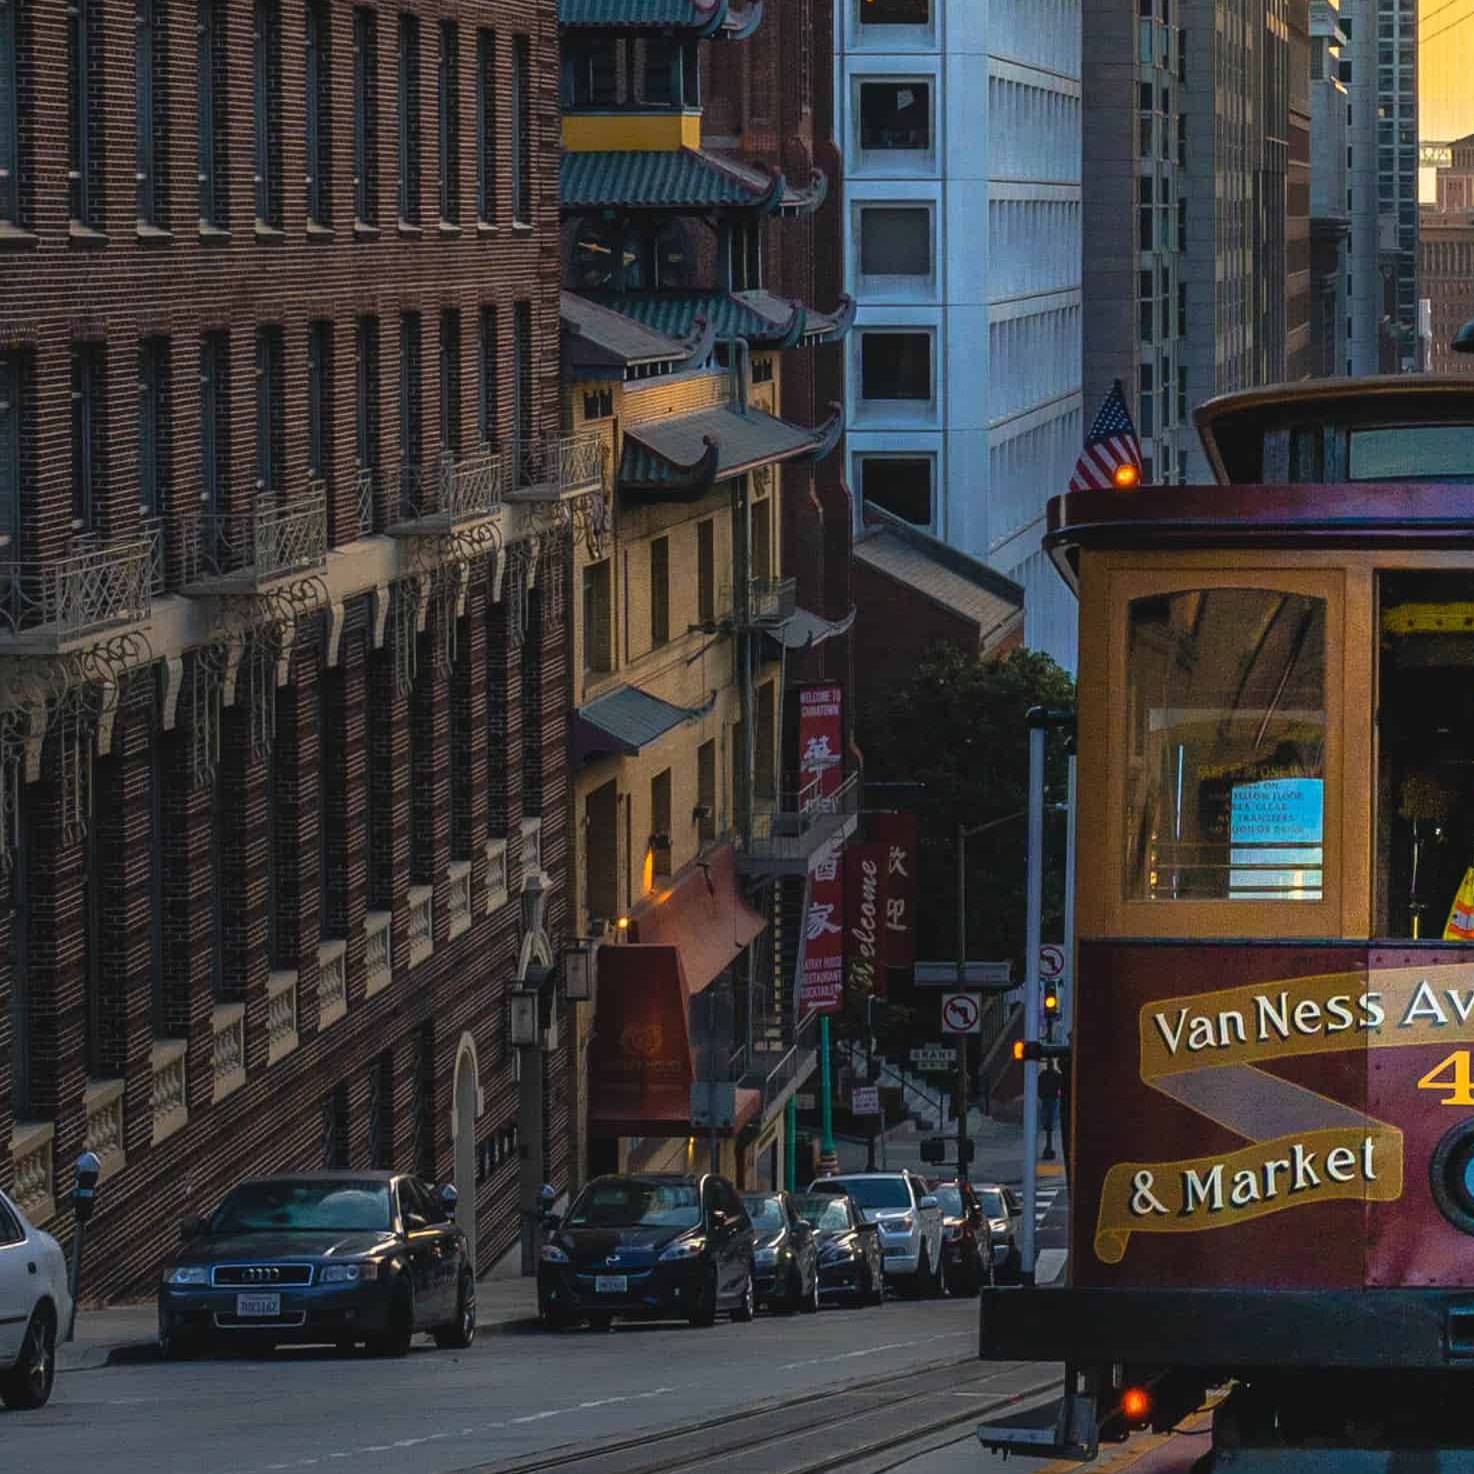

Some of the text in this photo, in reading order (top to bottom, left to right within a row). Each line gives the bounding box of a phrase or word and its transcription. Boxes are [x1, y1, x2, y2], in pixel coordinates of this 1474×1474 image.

[1155, 1007, 1247, 1055] Van
[1254, 992, 1385, 1039] Ness
[1131, 1136, 1377, 1215] & Market
